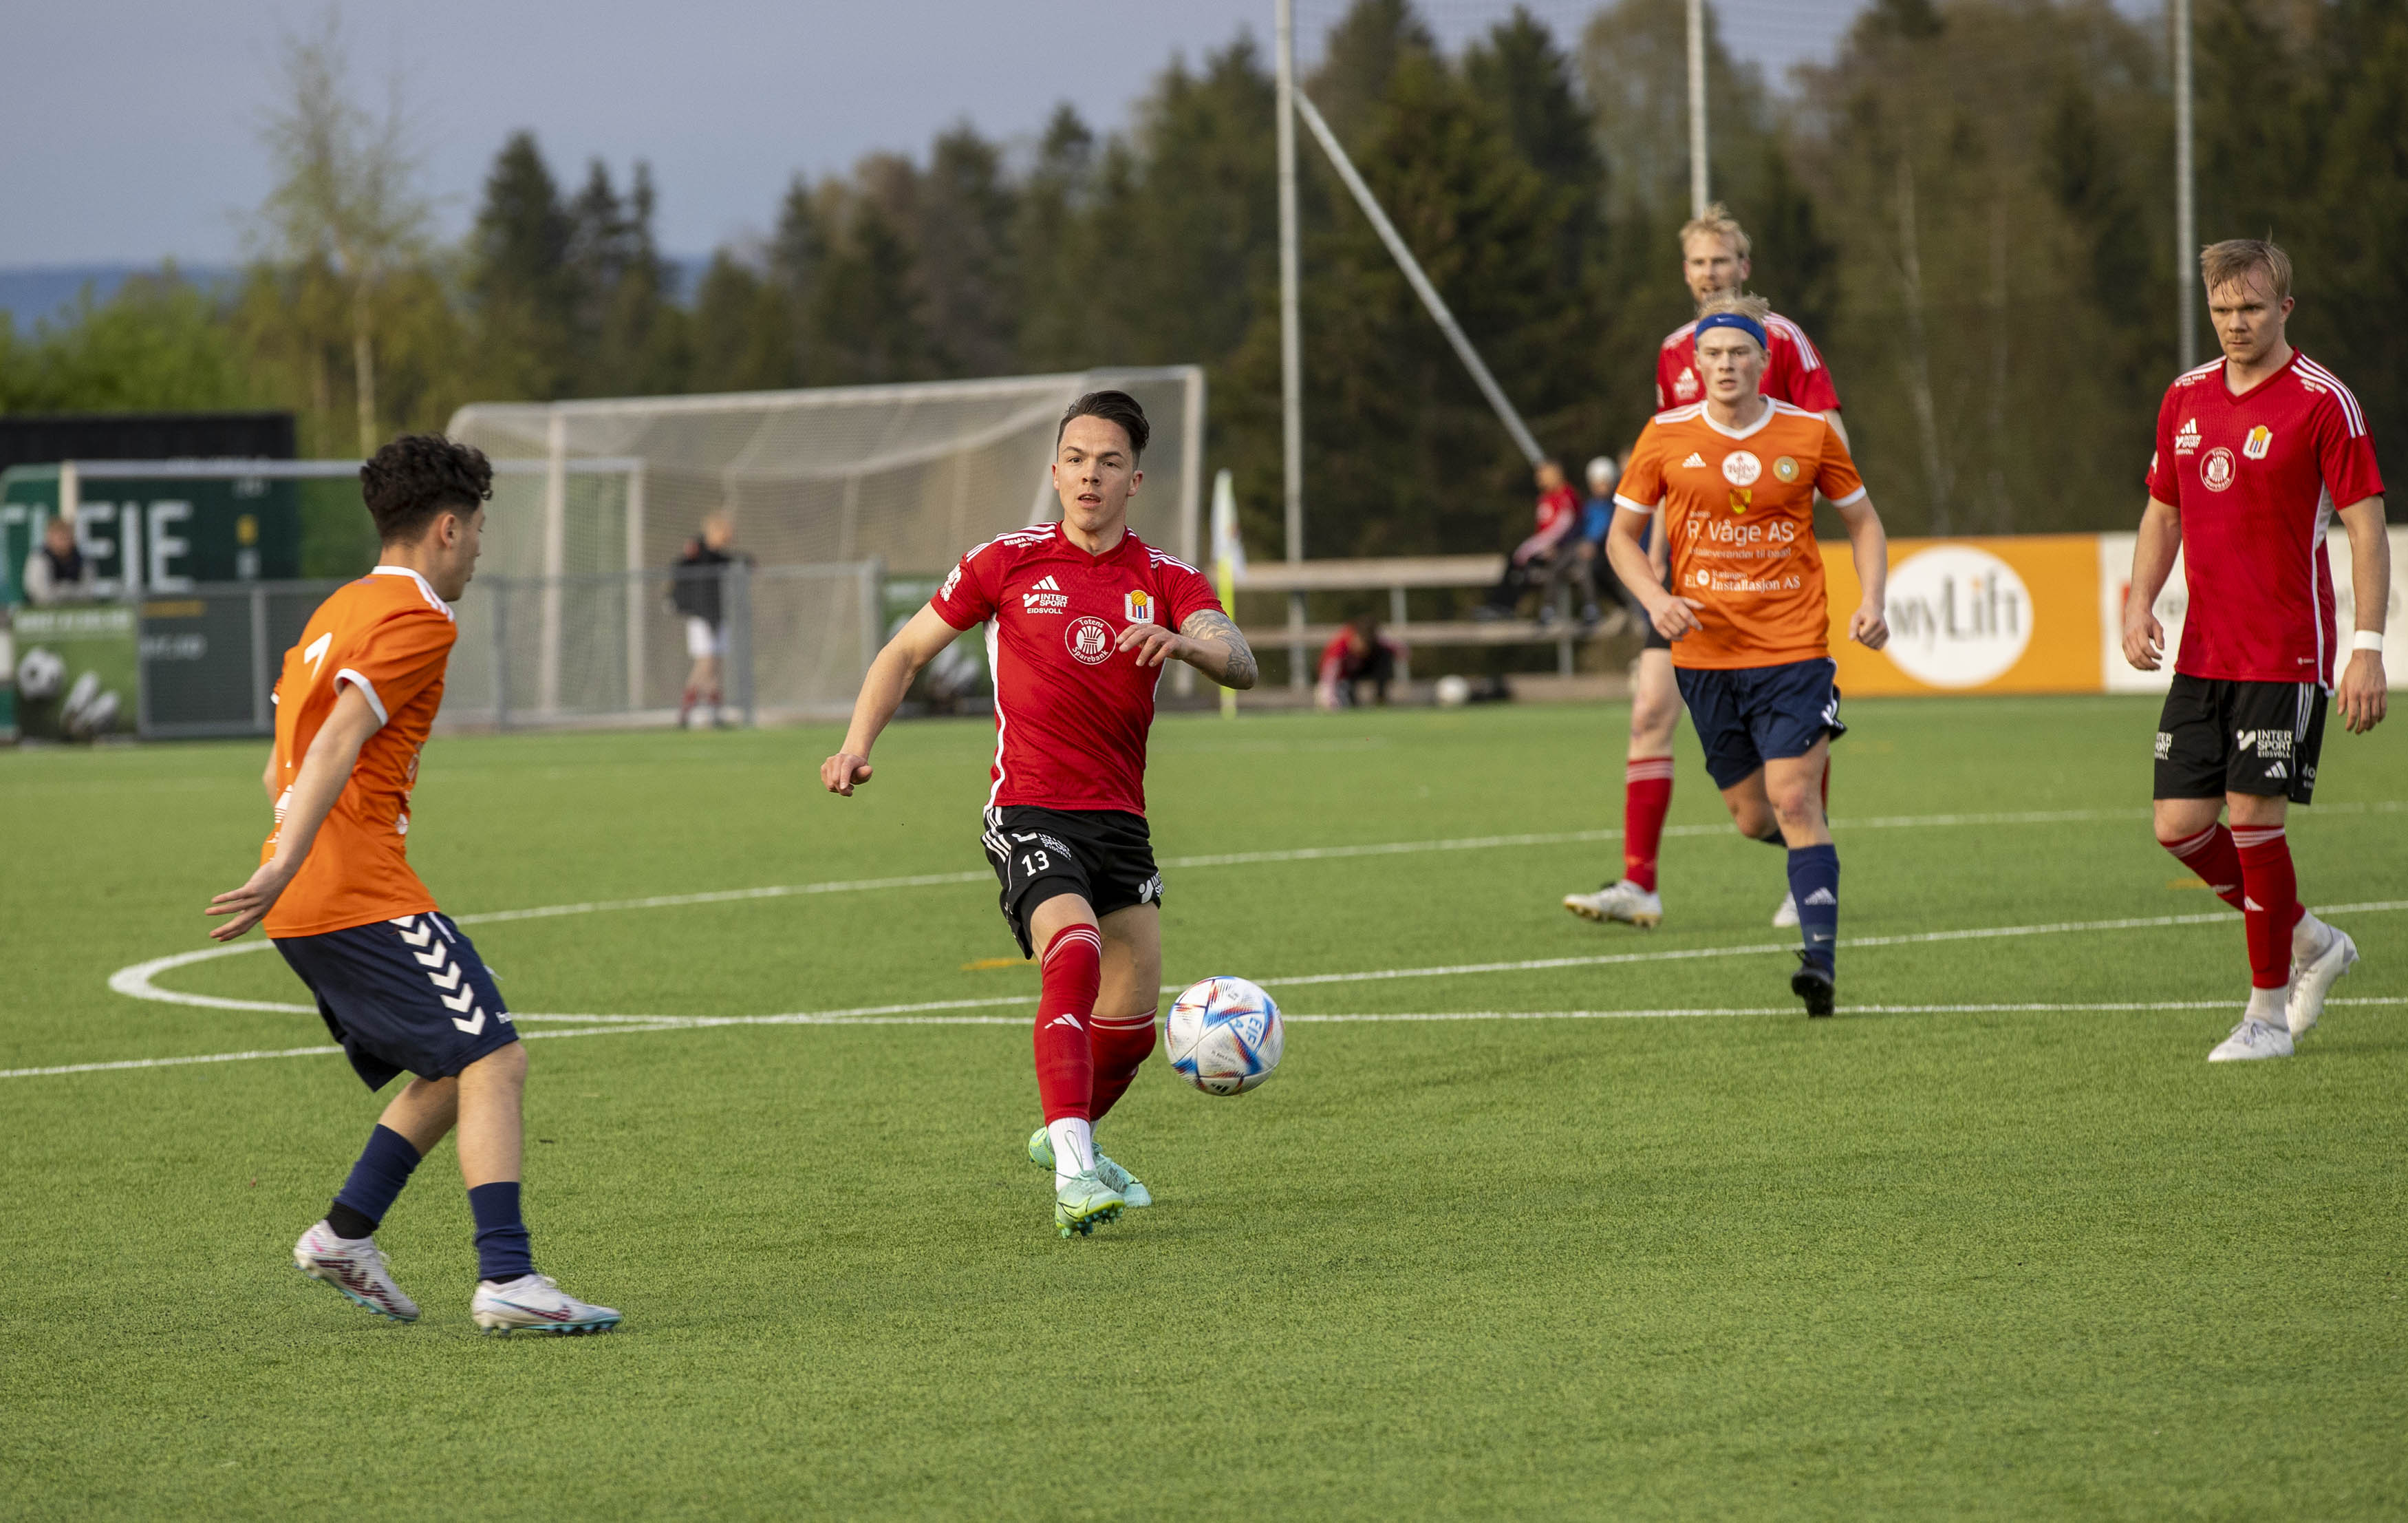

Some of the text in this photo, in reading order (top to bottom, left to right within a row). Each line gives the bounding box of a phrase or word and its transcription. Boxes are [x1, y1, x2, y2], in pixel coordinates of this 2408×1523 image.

[1708, 519, 1761, 546] Våge
[1768, 521, 1794, 542] AS
[1003, 537, 1026, 546] REMA
[1712, 575, 1800, 593] Installasjon AS
[1040, 593, 1068, 601] INTER
[1078, 619, 1104, 628] Totens
[1072, 646, 1109, 662] Sparebank
[2257, 729, 2292, 741] INTER
[2257, 740, 2290, 751] SPORT
[2257, 750, 2290, 758] EIDSVOLL
[1022, 850, 1050, 877] 13
